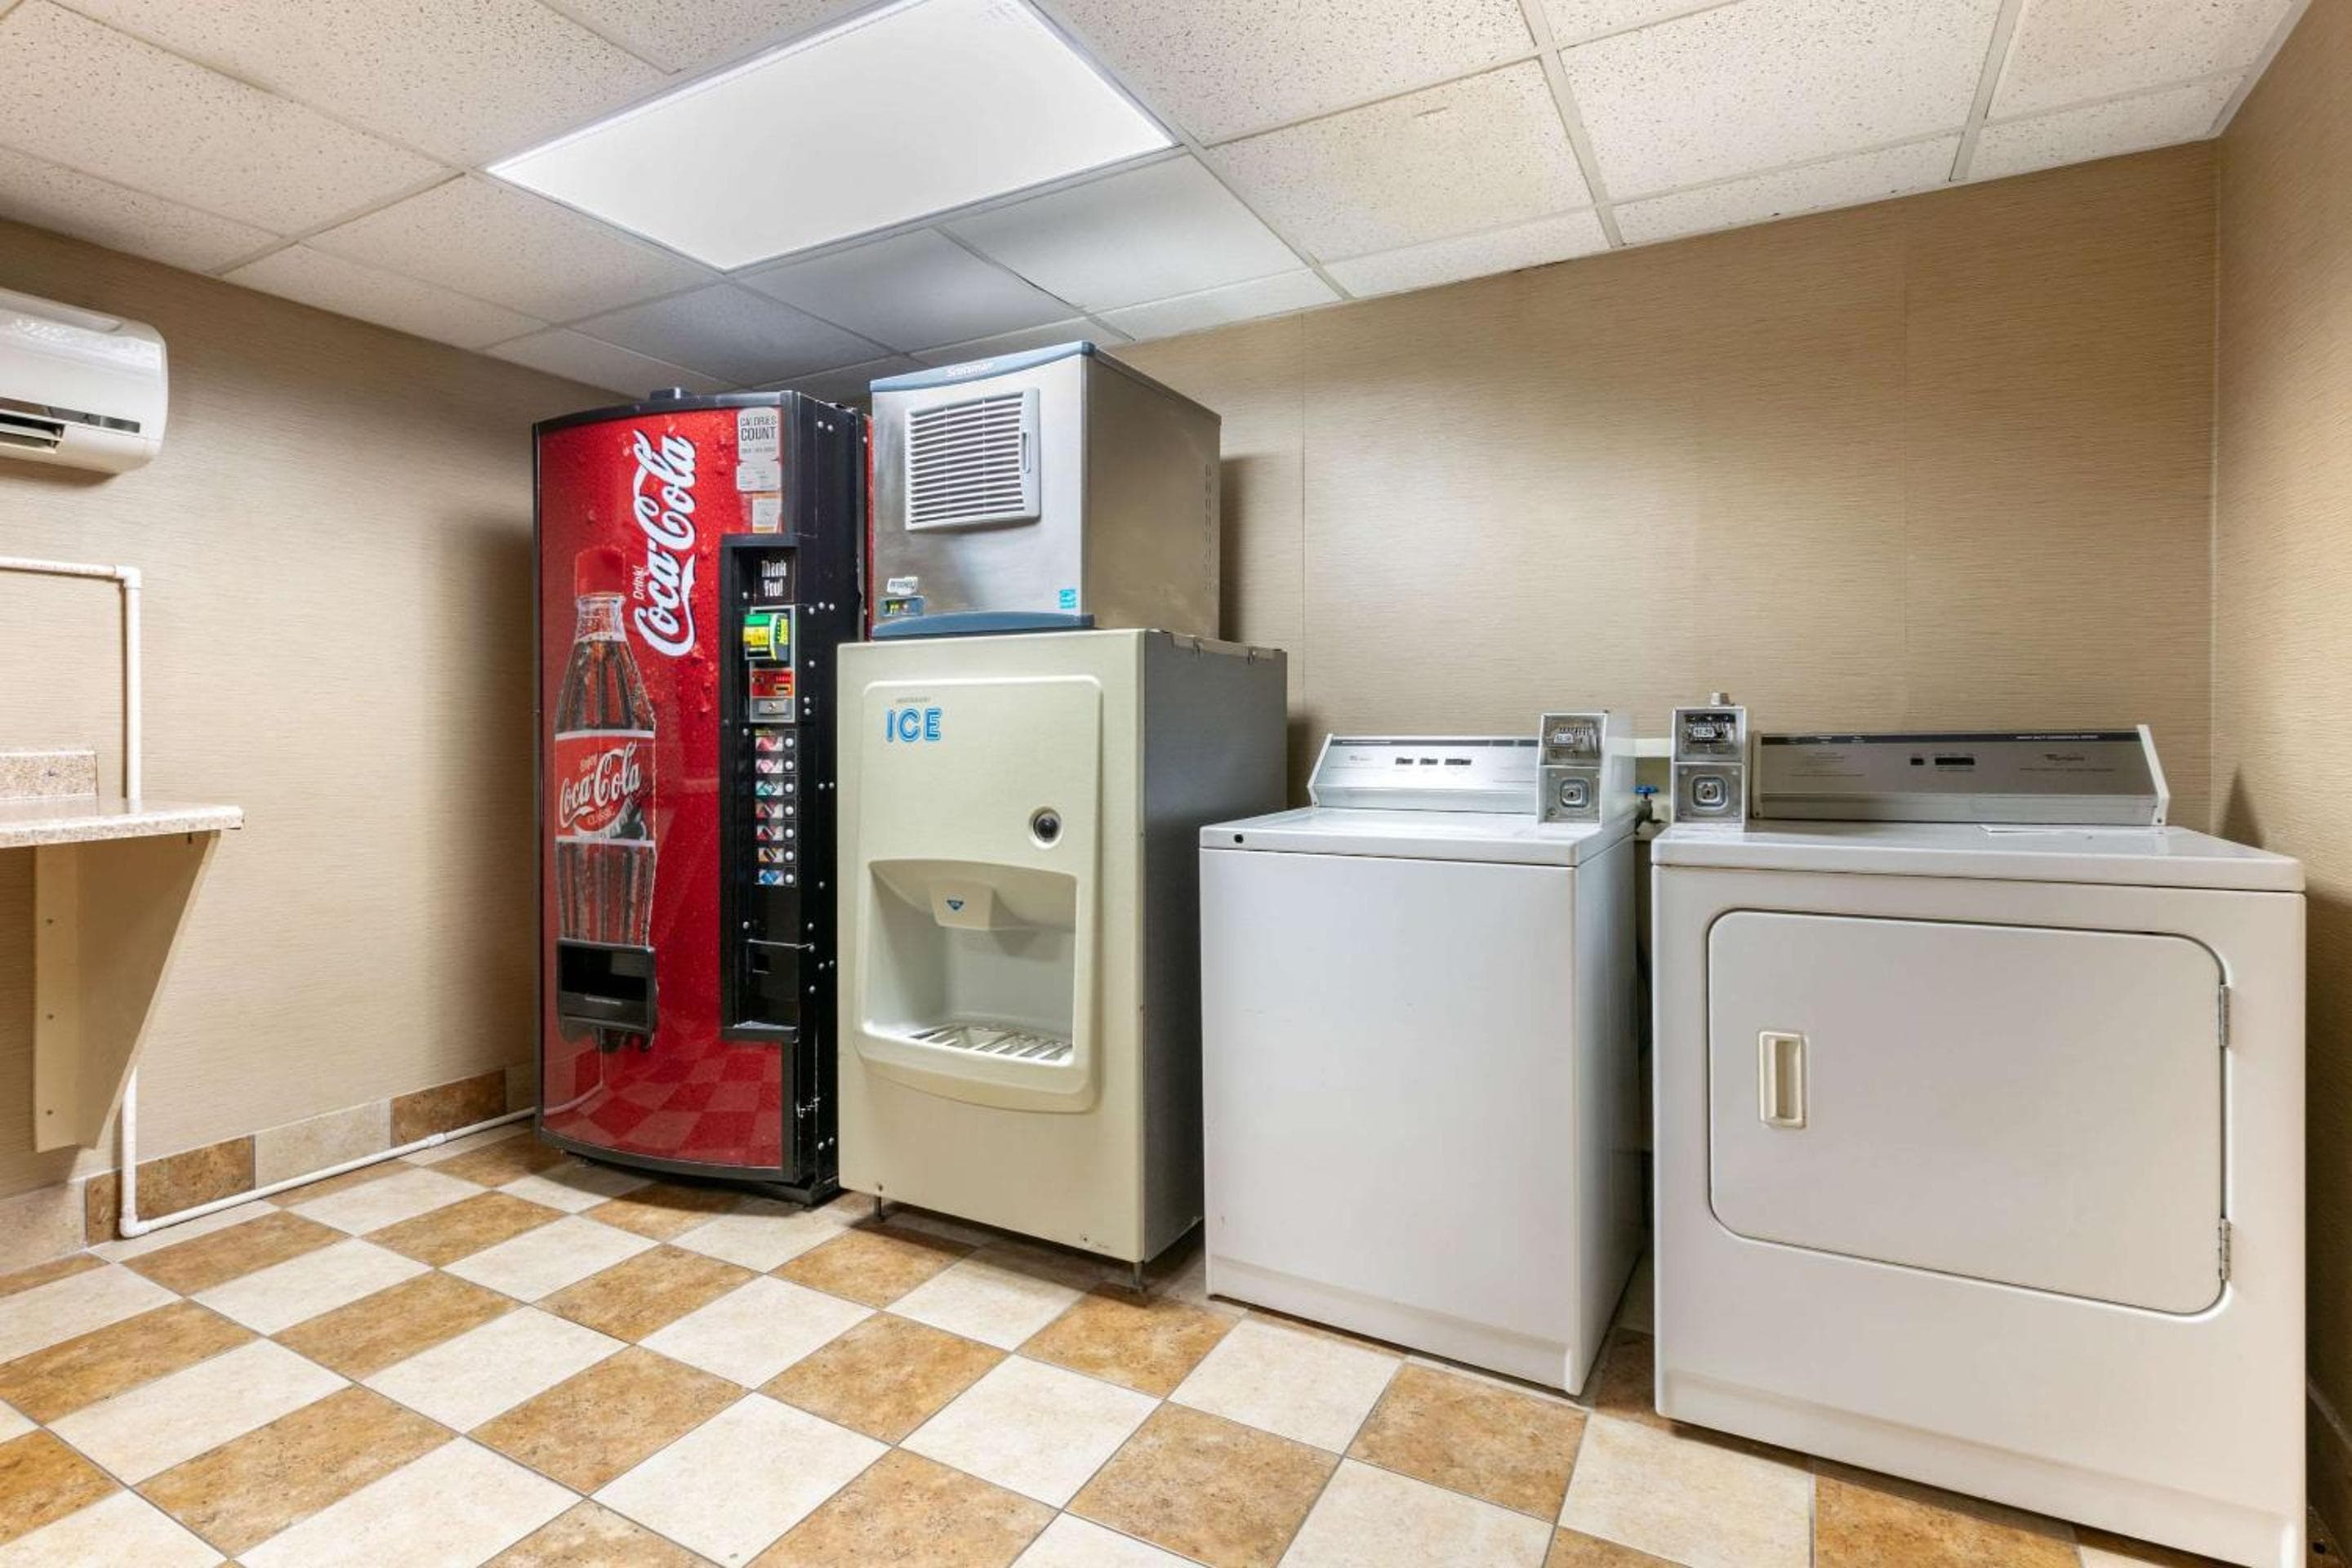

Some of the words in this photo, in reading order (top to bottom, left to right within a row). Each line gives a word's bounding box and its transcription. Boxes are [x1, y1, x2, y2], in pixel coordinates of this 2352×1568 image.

[741, 427, 776, 442] COUNT
[632, 429, 697, 657] Coca-Cola
[761, 559, 786, 578] Thank
[886, 708, 942, 742] ICE
